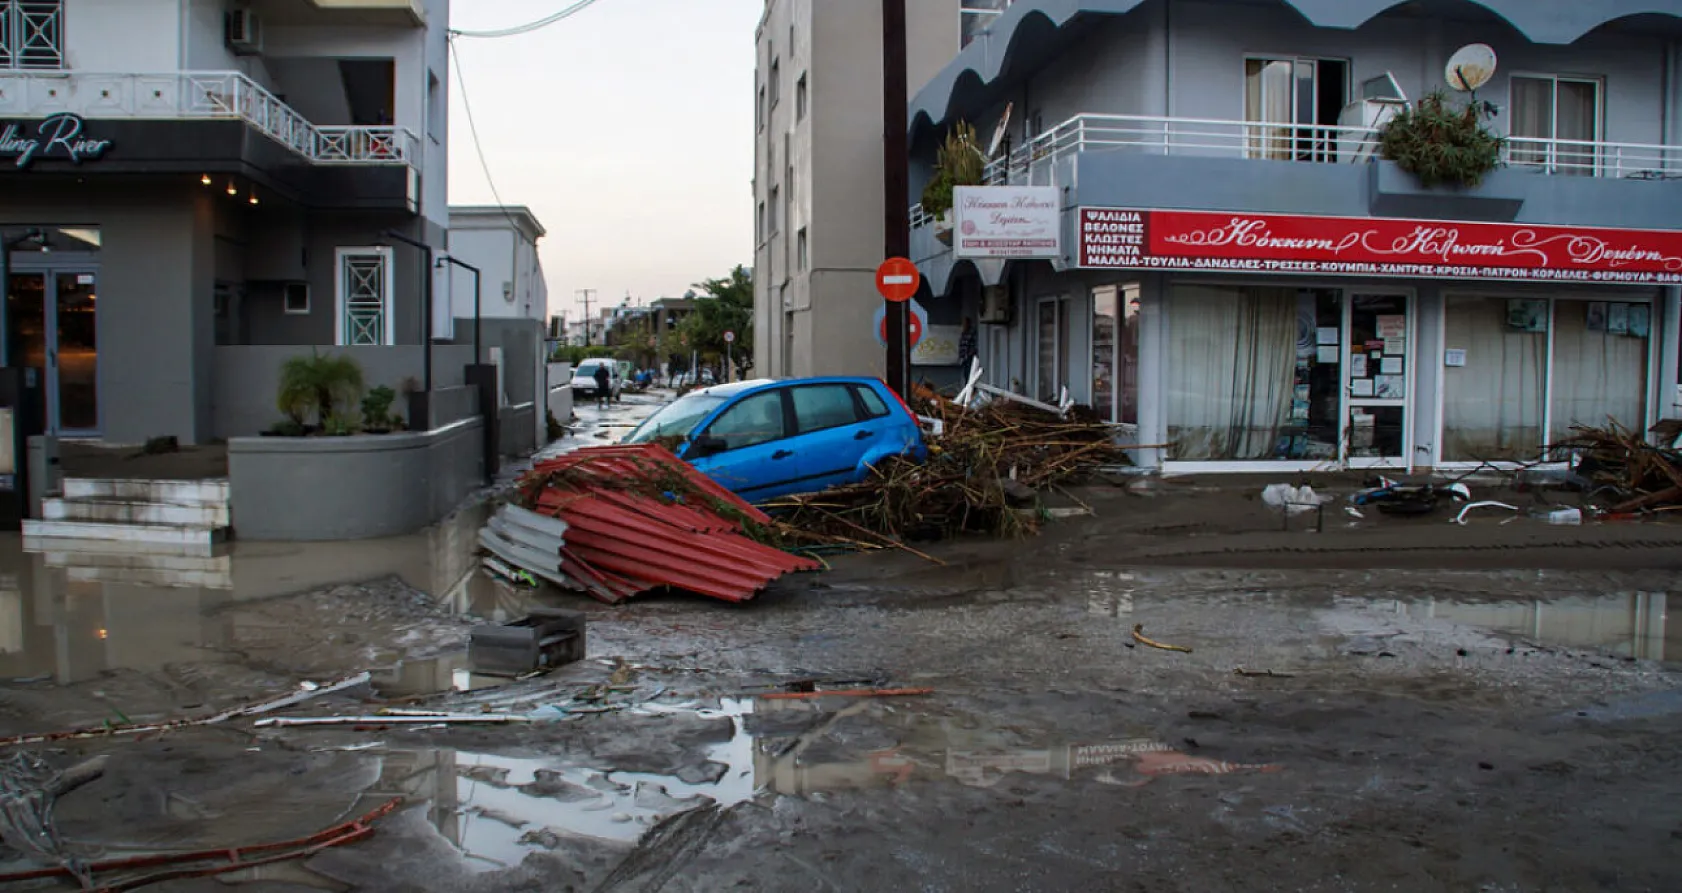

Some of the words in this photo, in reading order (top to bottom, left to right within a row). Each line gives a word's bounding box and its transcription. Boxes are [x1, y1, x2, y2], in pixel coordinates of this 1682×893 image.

[38, 112, 111, 163] River
[1086, 211, 1141, 222] ΨΑΛΙΔΙΑ
[1084, 222, 1144, 233] ΒΕΛΟΝΕΣ
[1085, 233, 1144, 244] ΚΛΩΣΤΕΣ
[1086, 244, 1140, 255] ΝΗΜΑΤΑ
